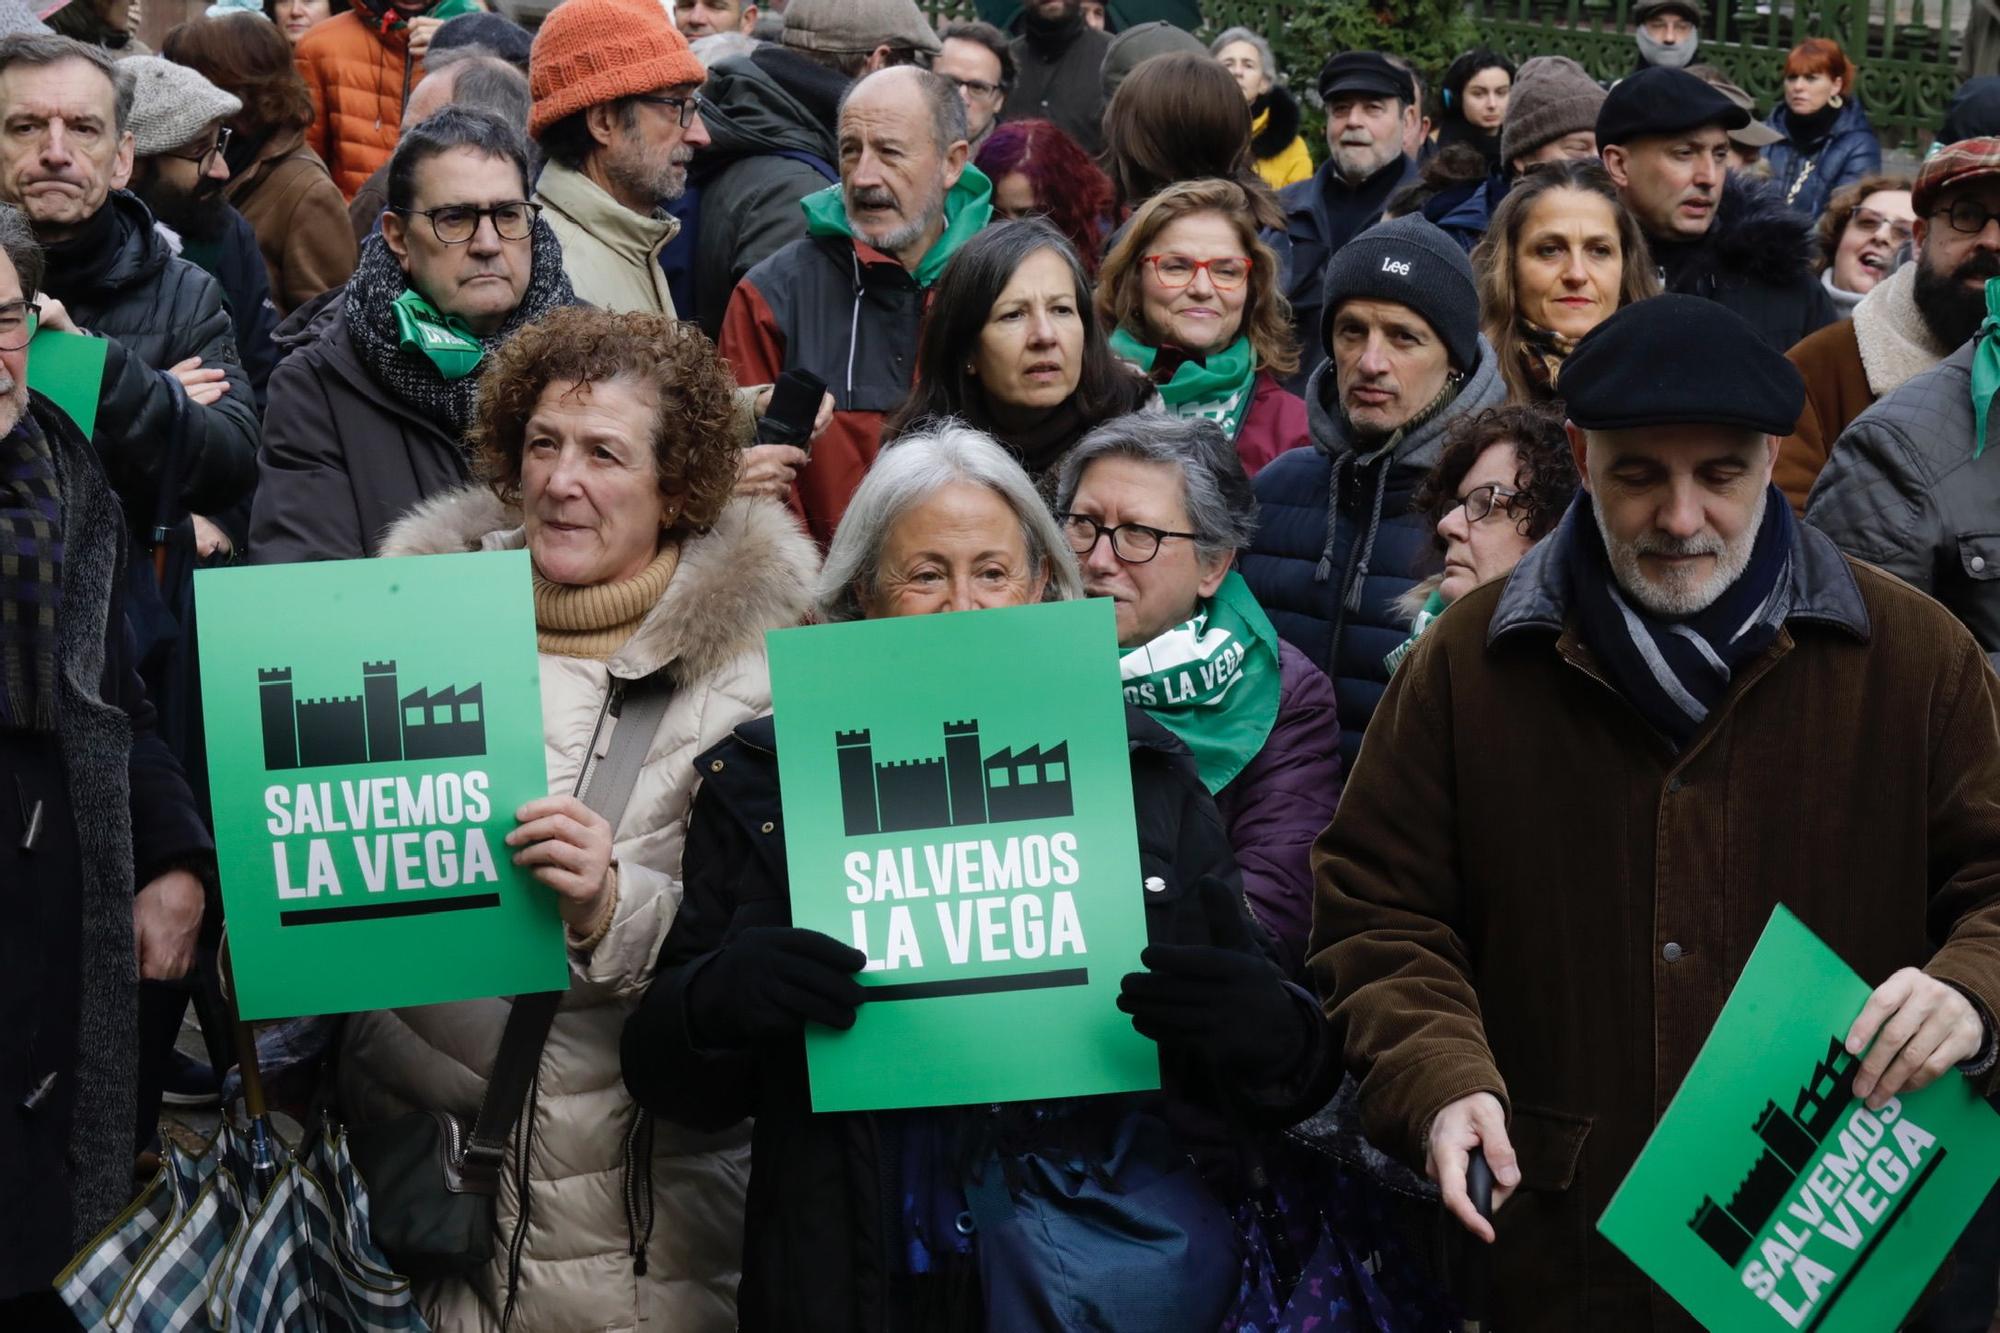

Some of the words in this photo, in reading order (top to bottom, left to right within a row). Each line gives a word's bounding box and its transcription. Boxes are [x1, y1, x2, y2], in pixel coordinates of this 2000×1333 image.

[1382, 257, 1410, 275] Lee
[1162, 671, 1197, 704] LA
[1199, 641, 1245, 691] VEGA
[264, 770, 491, 836] SALVEMOS
[272, 838, 343, 900] LA
[352, 828, 499, 893] VEGA
[844, 832, 1080, 904] SALVEMOS
[851, 905, 924, 972] LA
[935, 891, 1087, 965] VEGA
[1767, 1253, 1837, 1329] LA
[1818, 1117, 1937, 1250] VEGA
